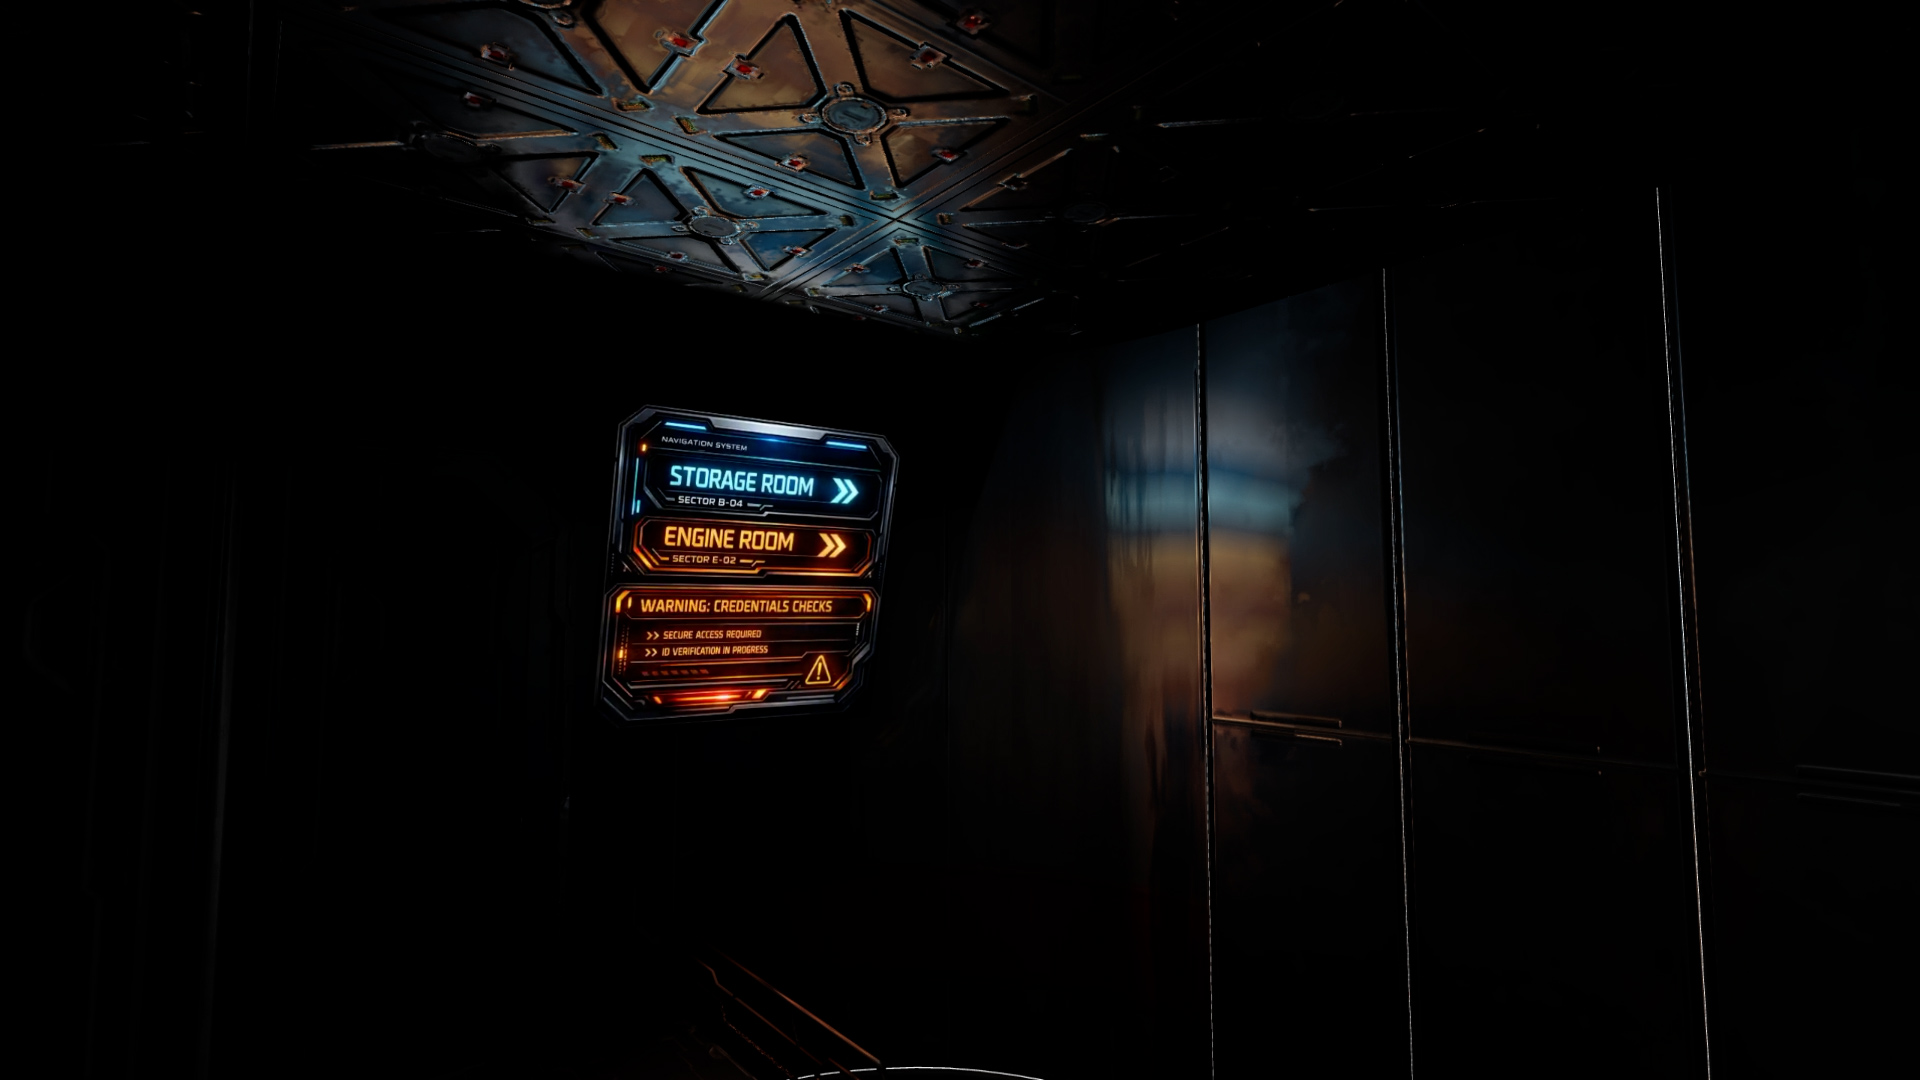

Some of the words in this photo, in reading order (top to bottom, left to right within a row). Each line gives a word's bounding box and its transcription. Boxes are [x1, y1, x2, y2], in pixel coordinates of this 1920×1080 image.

[662, 436, 713, 448] NAVIGATION
[715, 442, 748, 451] SYSTEM
[670, 465, 758, 492] STORAGE
[761, 473, 814, 496] ROOM
[678, 495, 716, 506] SECTOR
[718, 499, 743, 508] B-04
[664, 526, 735, 549] ENGINE
[739, 531, 794, 552] ROOM
[672, 554, 710, 564] SECTOR
[712, 556, 737, 565] E-02
[641, 599, 711, 613] WARNING:
[714, 599, 789, 613] CREDENTIALS
[792, 600, 832, 613] CHECKS
[663, 630, 693, 640] SECURE
[695, 630, 724, 639] ACCESS
[726, 629, 762, 639] REQUIRED
[662, 647, 670, 656] ID
[672, 646, 720, 656] VERIFICATION
[722, 646, 730, 655] IN
[732, 645, 768, 654] PROGRESS
